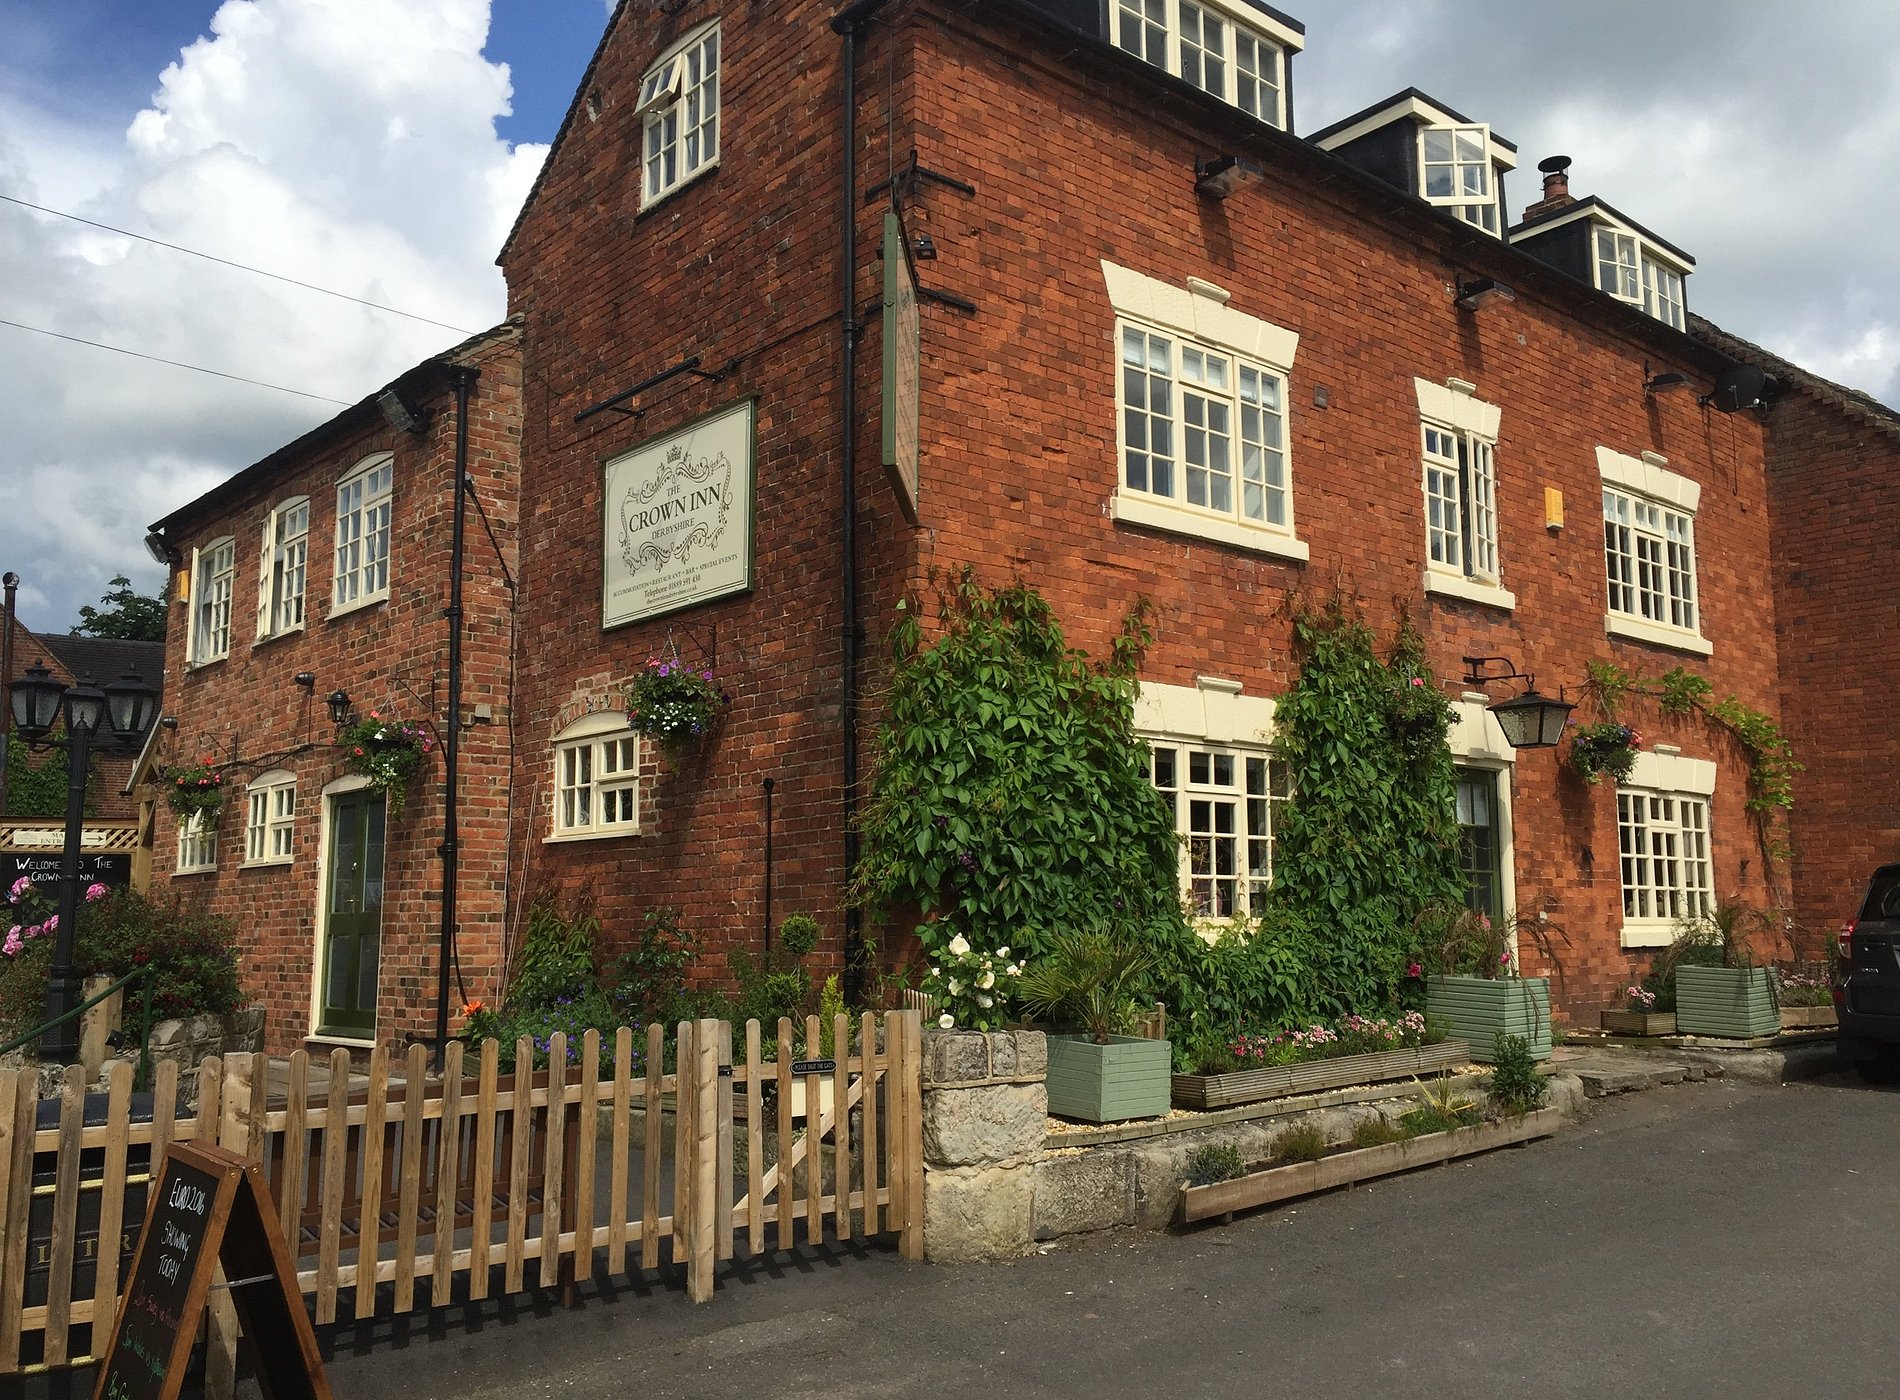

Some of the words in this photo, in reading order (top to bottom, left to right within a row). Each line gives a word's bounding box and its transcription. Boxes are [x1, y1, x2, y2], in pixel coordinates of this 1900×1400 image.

[666, 484, 681, 497] THE
[629, 496, 687, 532] CROWN
[690, 483, 721, 511] INN
[651, 518, 695, 540] DERBYSHIRE
[652, 571, 681, 586] RESTAURANT
[686, 567, 696, 576] BAR
[700, 560, 718, 570] SPECIAL
[718, 553, 738, 565] EVENTS
[644, 585, 668, 598] Telephone
[15, 857, 62, 870] WELCOME
[79, 873, 95, 881] NN
[158, 1253, 181, 1286] TODAY
